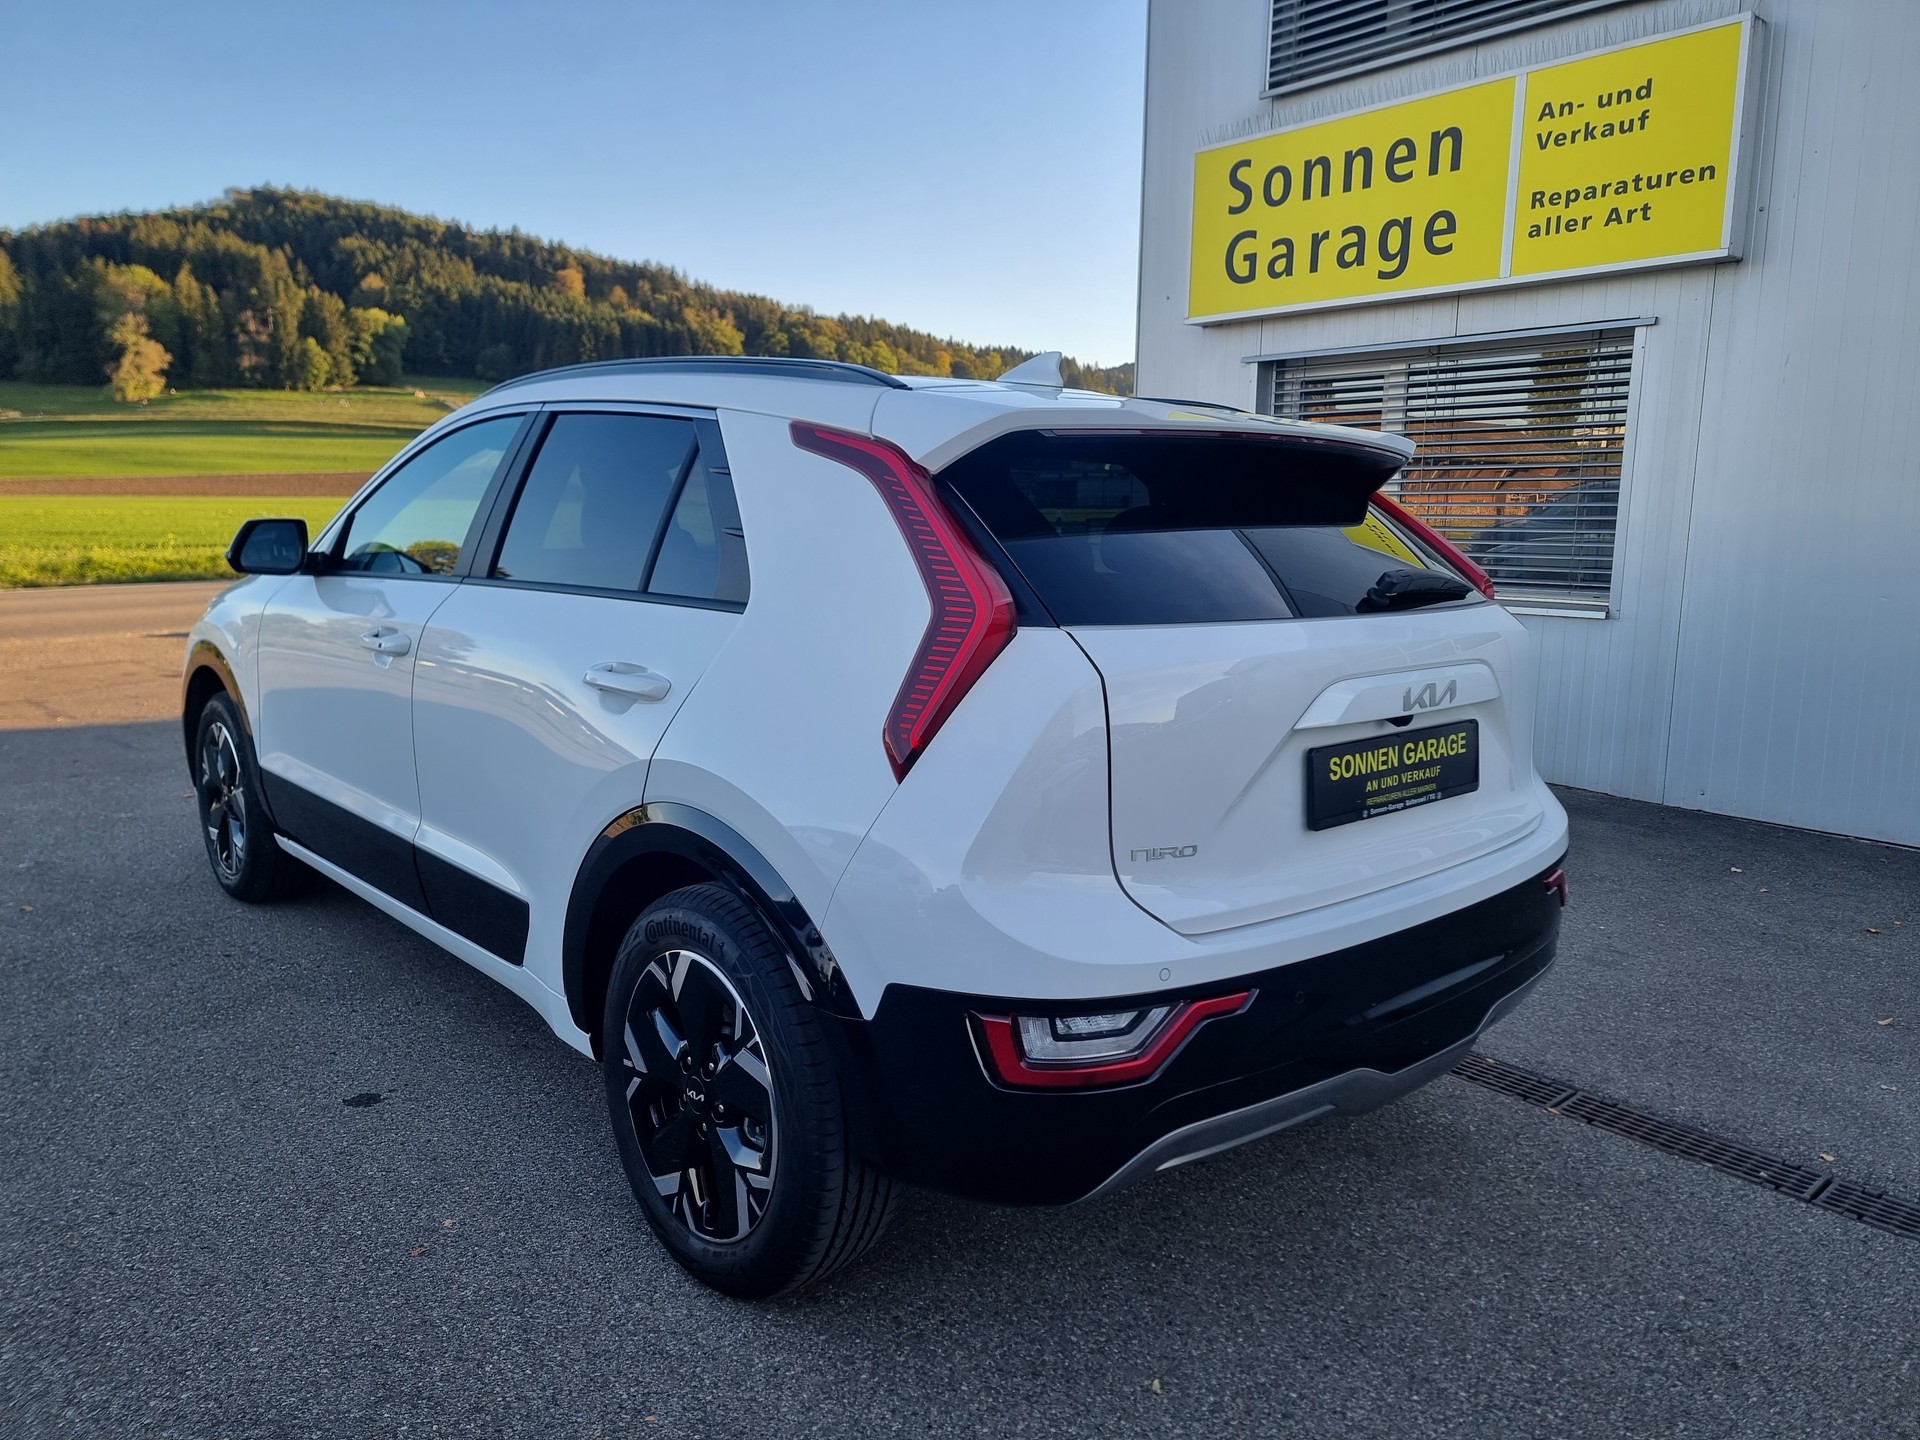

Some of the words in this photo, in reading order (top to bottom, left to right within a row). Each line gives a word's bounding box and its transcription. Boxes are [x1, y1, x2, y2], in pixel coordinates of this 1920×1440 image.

[1537, 99, 1586, 122] An-
[1597, 78, 1654, 109] und
[1536, 109, 1651, 151] Verkauf
[1227, 125, 1464, 216] Sonnen
[1530, 163, 1716, 210] Reparaturen
[1527, 213, 1593, 240] aller
[1603, 201, 1653, 227] Art
[1224, 208, 1457, 284] Garage
[1329, 745, 1399, 781] SONNEN
[1403, 732, 1467, 765] GARAGE
[1366, 780, 1378, 792] AN
[1381, 775, 1399, 789] UND
[1401, 765, 1441, 784] VERKAUF
[645, 914, 717, 953] Continental
